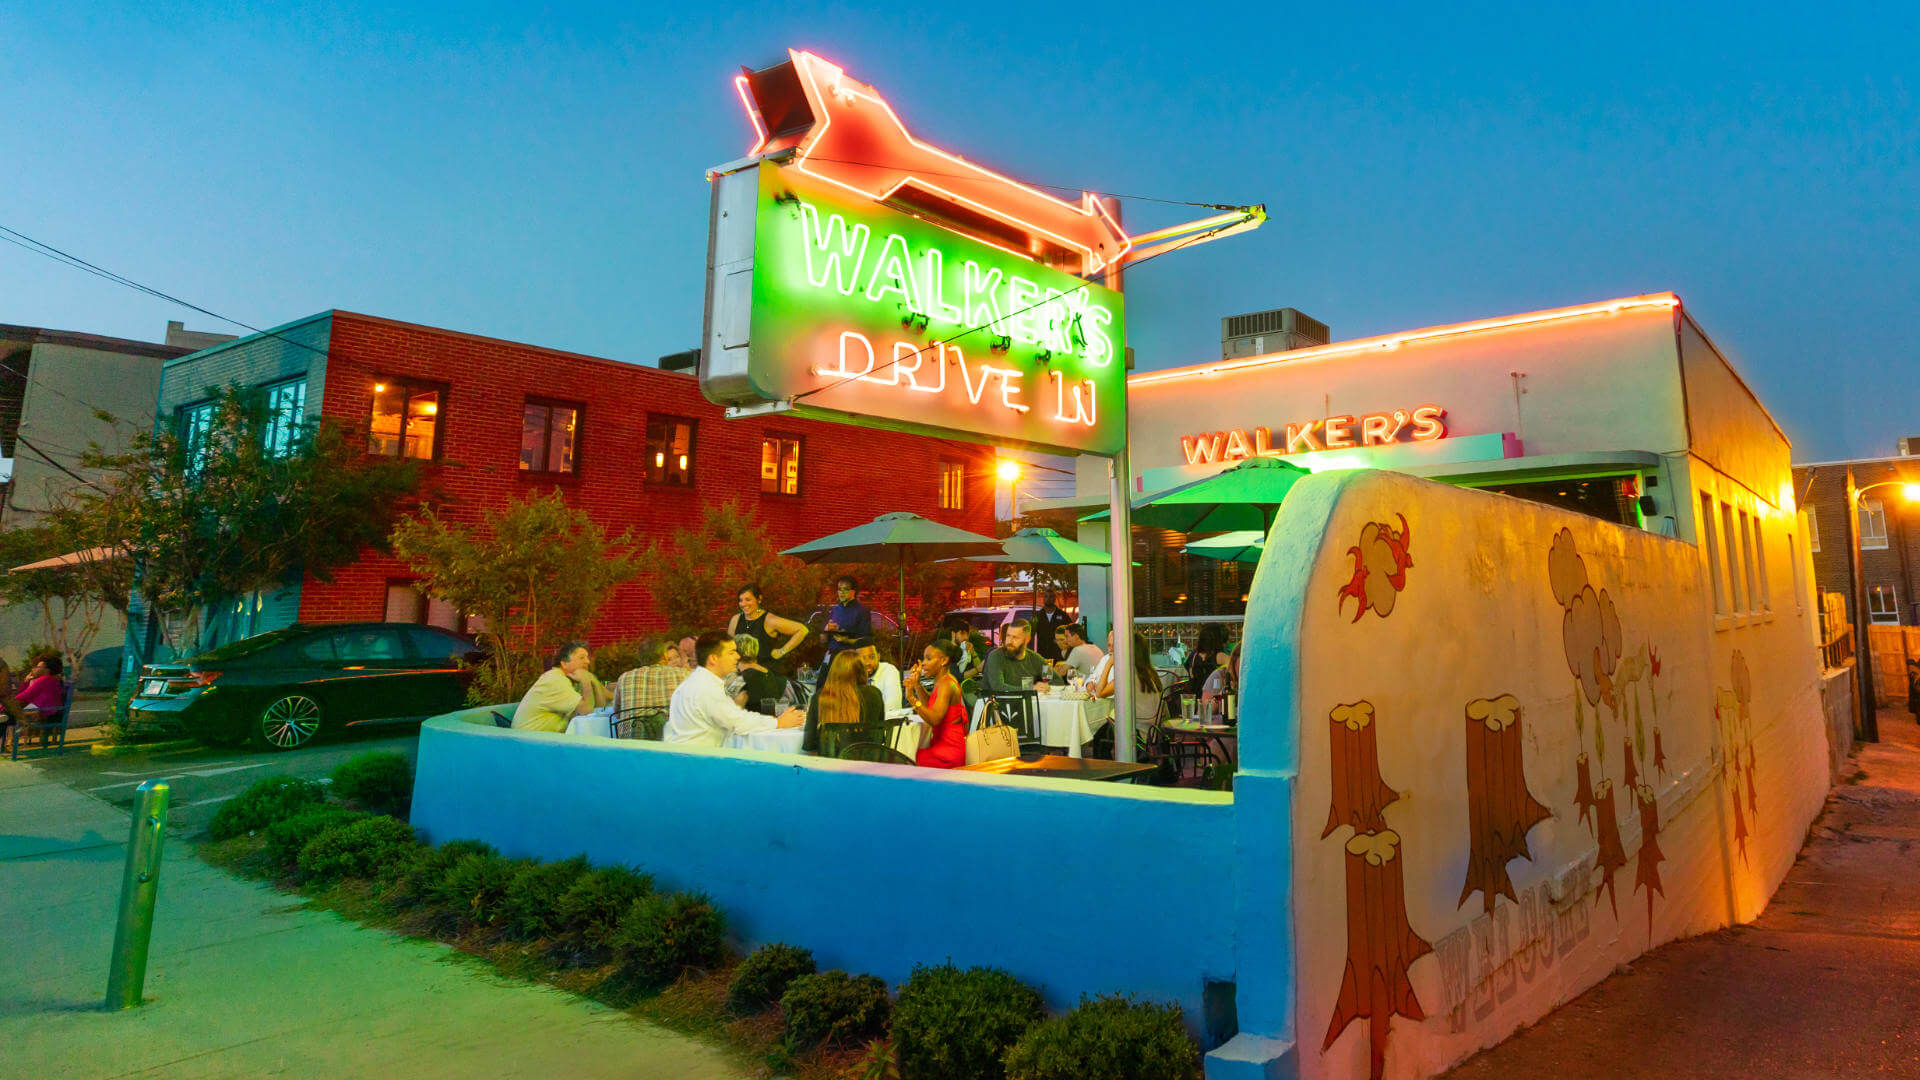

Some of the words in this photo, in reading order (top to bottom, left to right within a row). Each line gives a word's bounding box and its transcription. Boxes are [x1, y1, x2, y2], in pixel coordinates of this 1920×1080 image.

[798, 202, 1113, 368] WALKER'S
[815, 331, 1030, 413] DRIVE
[1049, 370, 1097, 427] IN
[1181, 404, 1449, 465] WALKER'S
